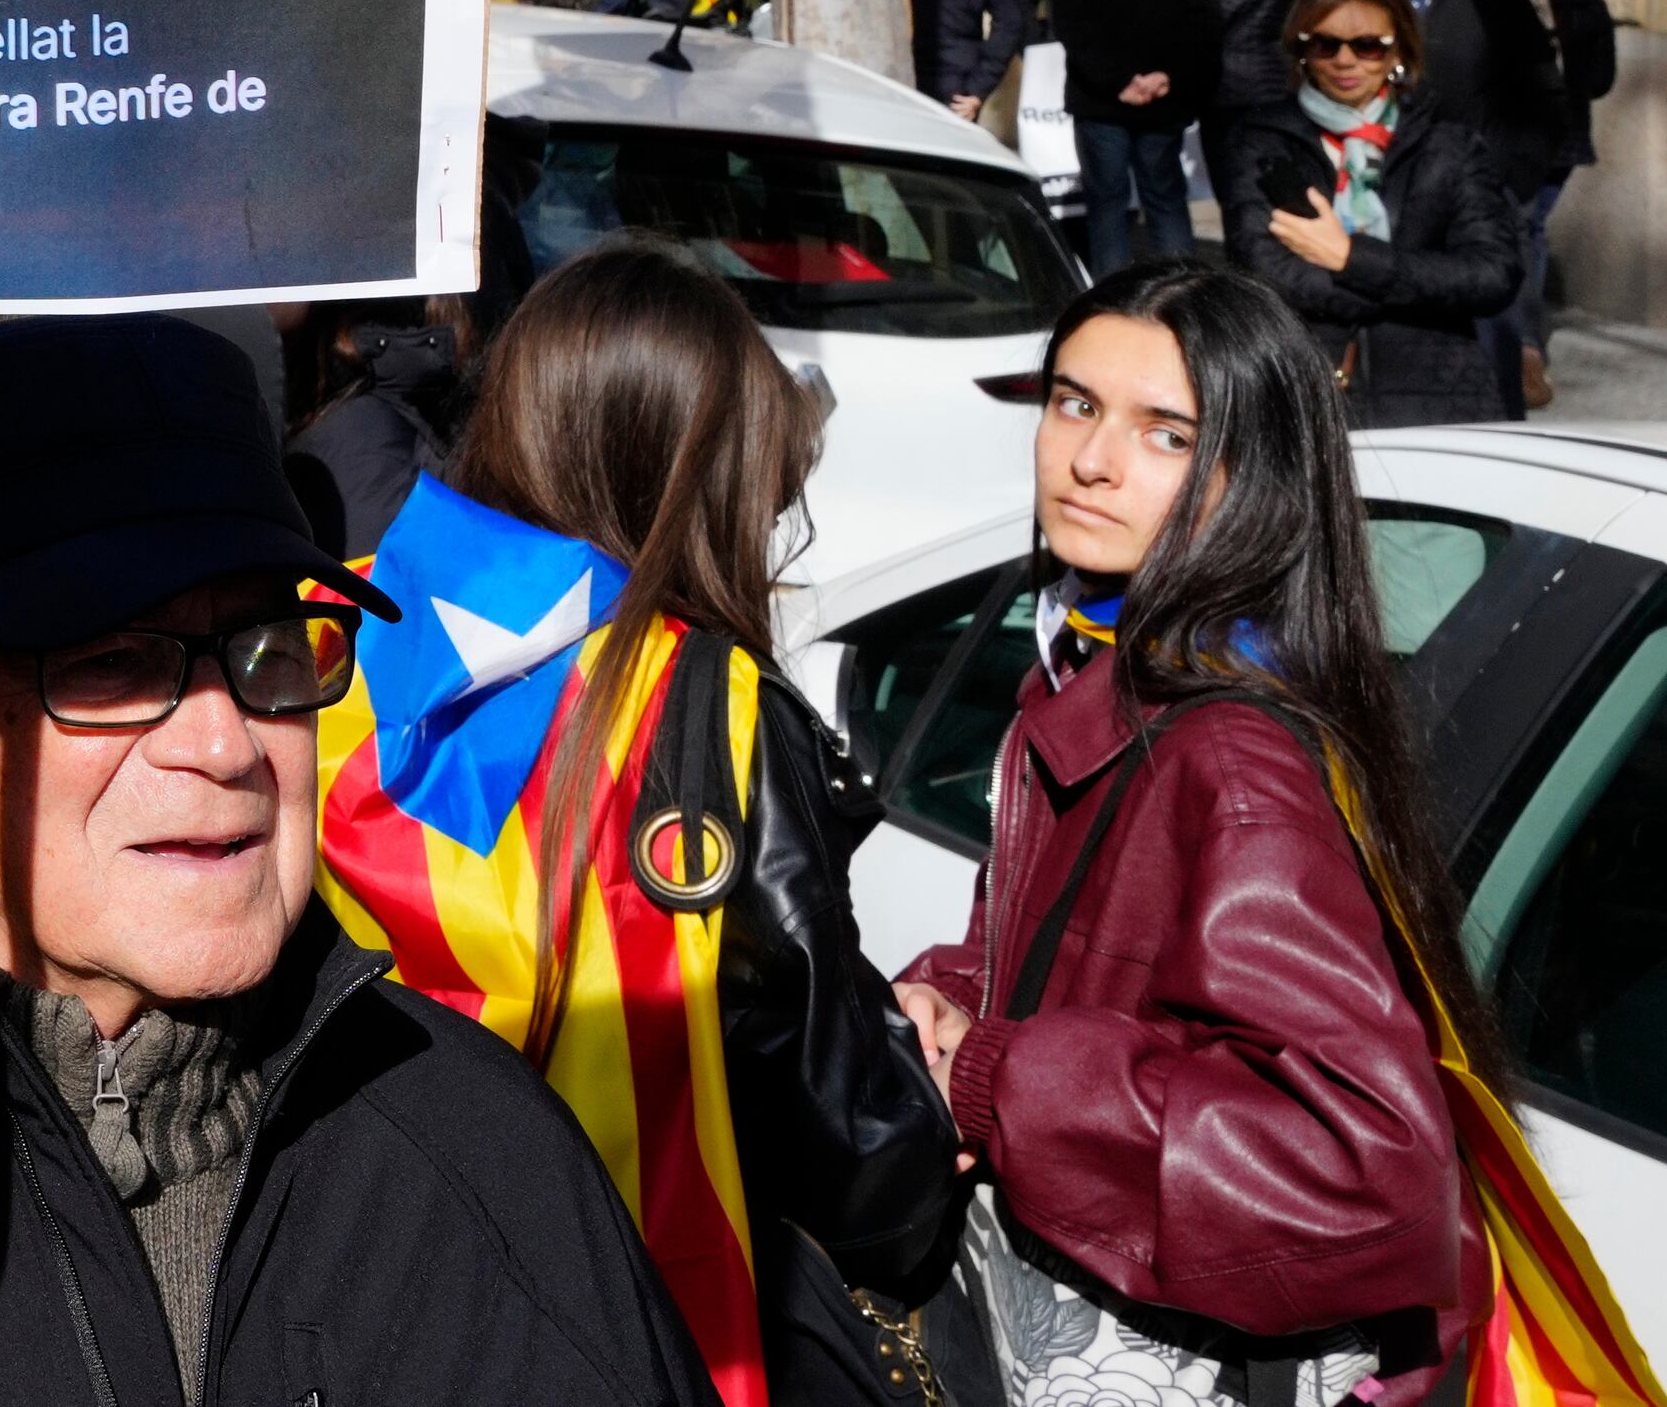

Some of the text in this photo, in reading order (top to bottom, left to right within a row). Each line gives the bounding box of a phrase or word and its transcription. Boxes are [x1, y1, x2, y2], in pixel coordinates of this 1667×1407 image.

[91, 14, 130, 57] la
[56, 73, 193, 127] Renfe
[207, 70, 267, 114] de
